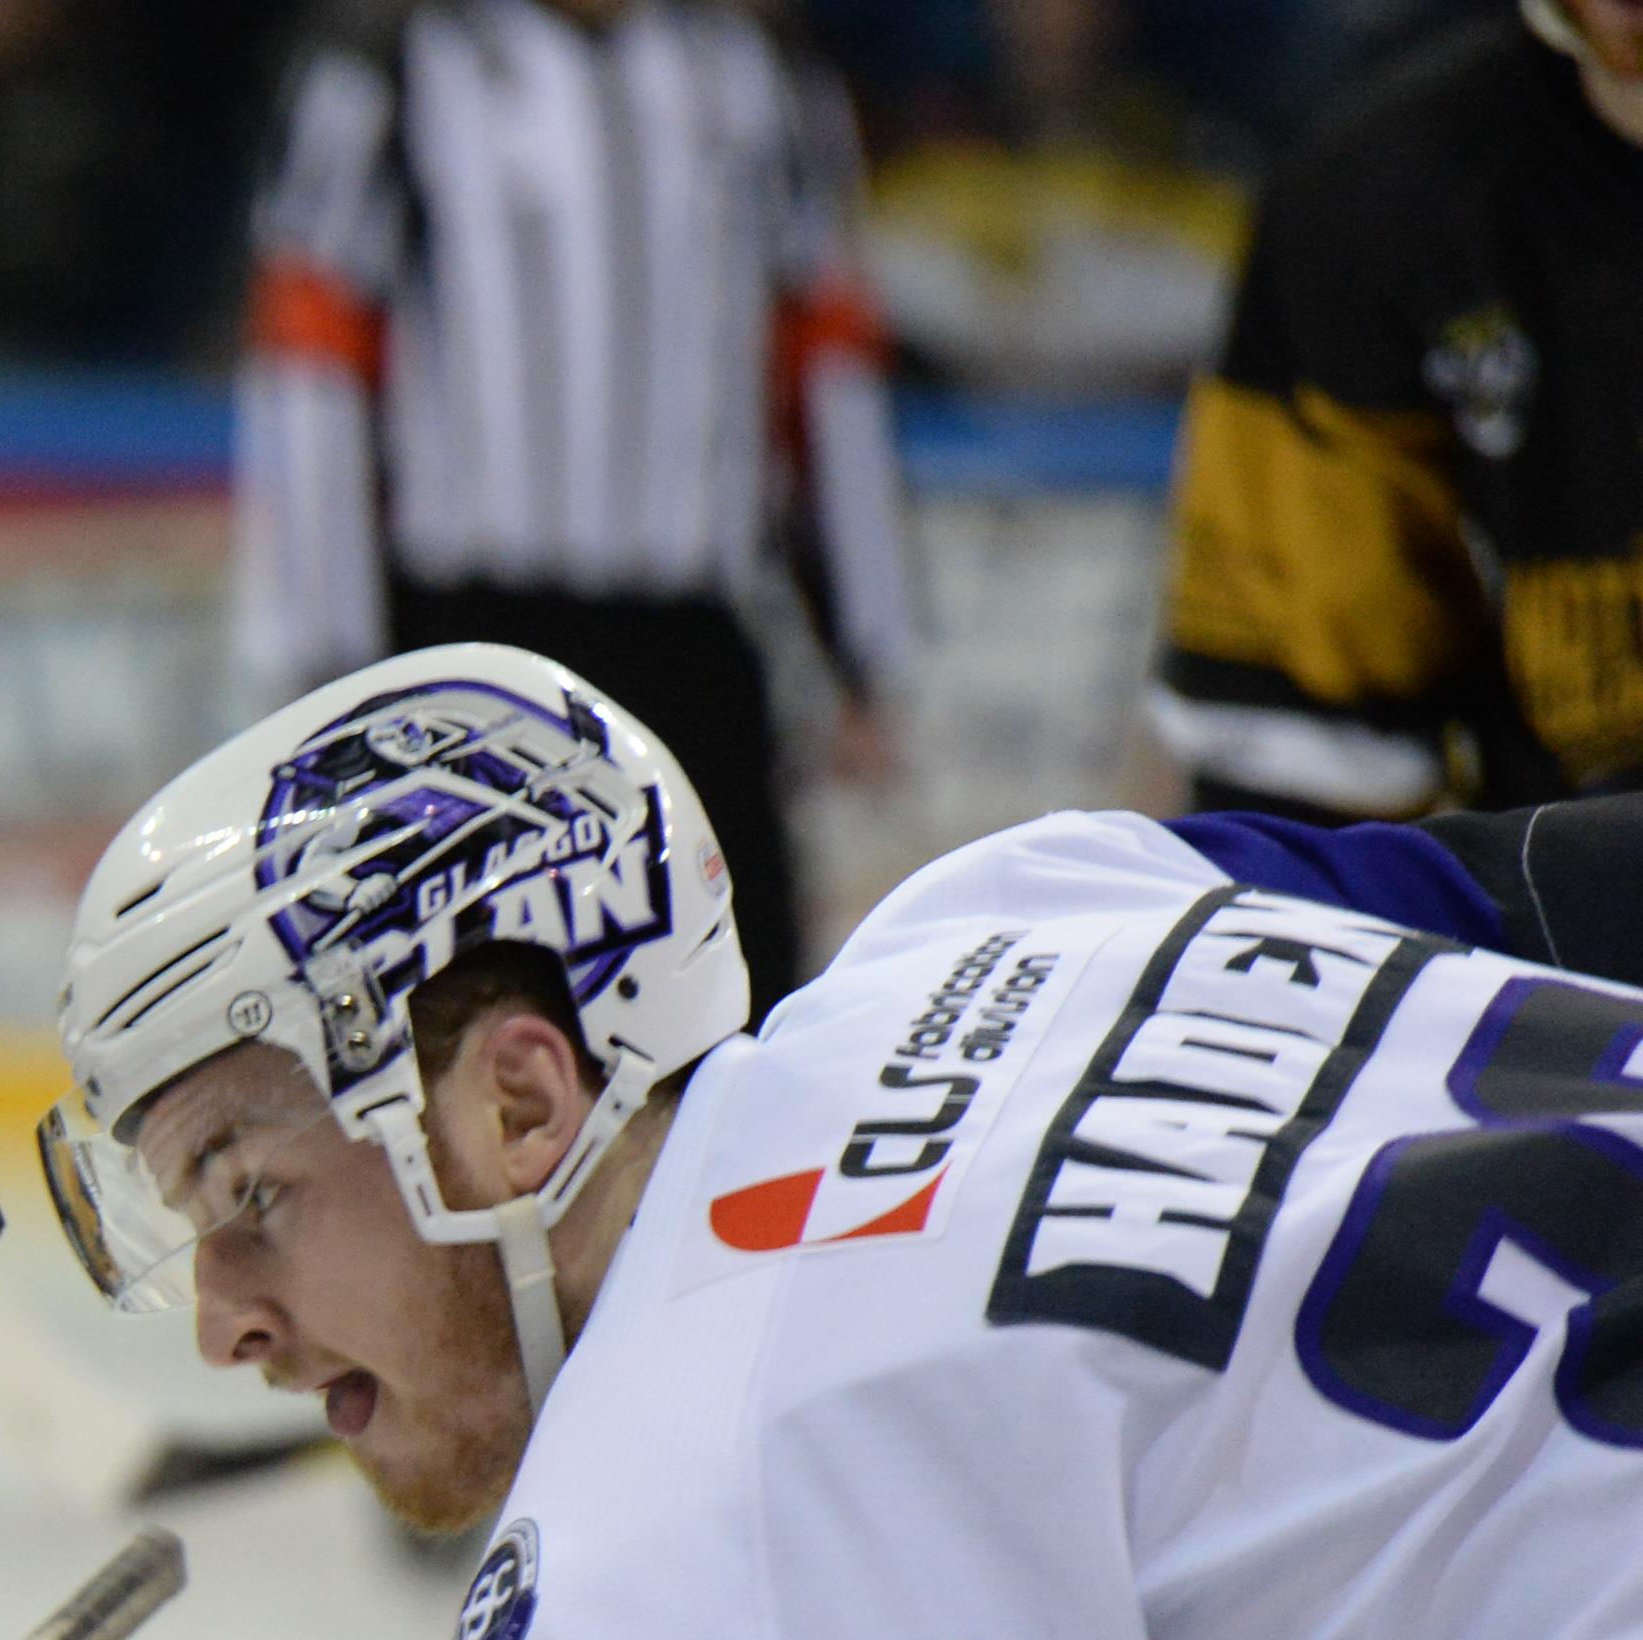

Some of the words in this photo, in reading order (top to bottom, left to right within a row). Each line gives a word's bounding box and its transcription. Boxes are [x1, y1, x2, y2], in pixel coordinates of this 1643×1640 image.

[418, 808, 620, 920] GLASGO
[895, 928, 1032, 1061] fabrication
[960, 951, 1062, 1064] division
[839, 1062, 983, 1179] CLS
